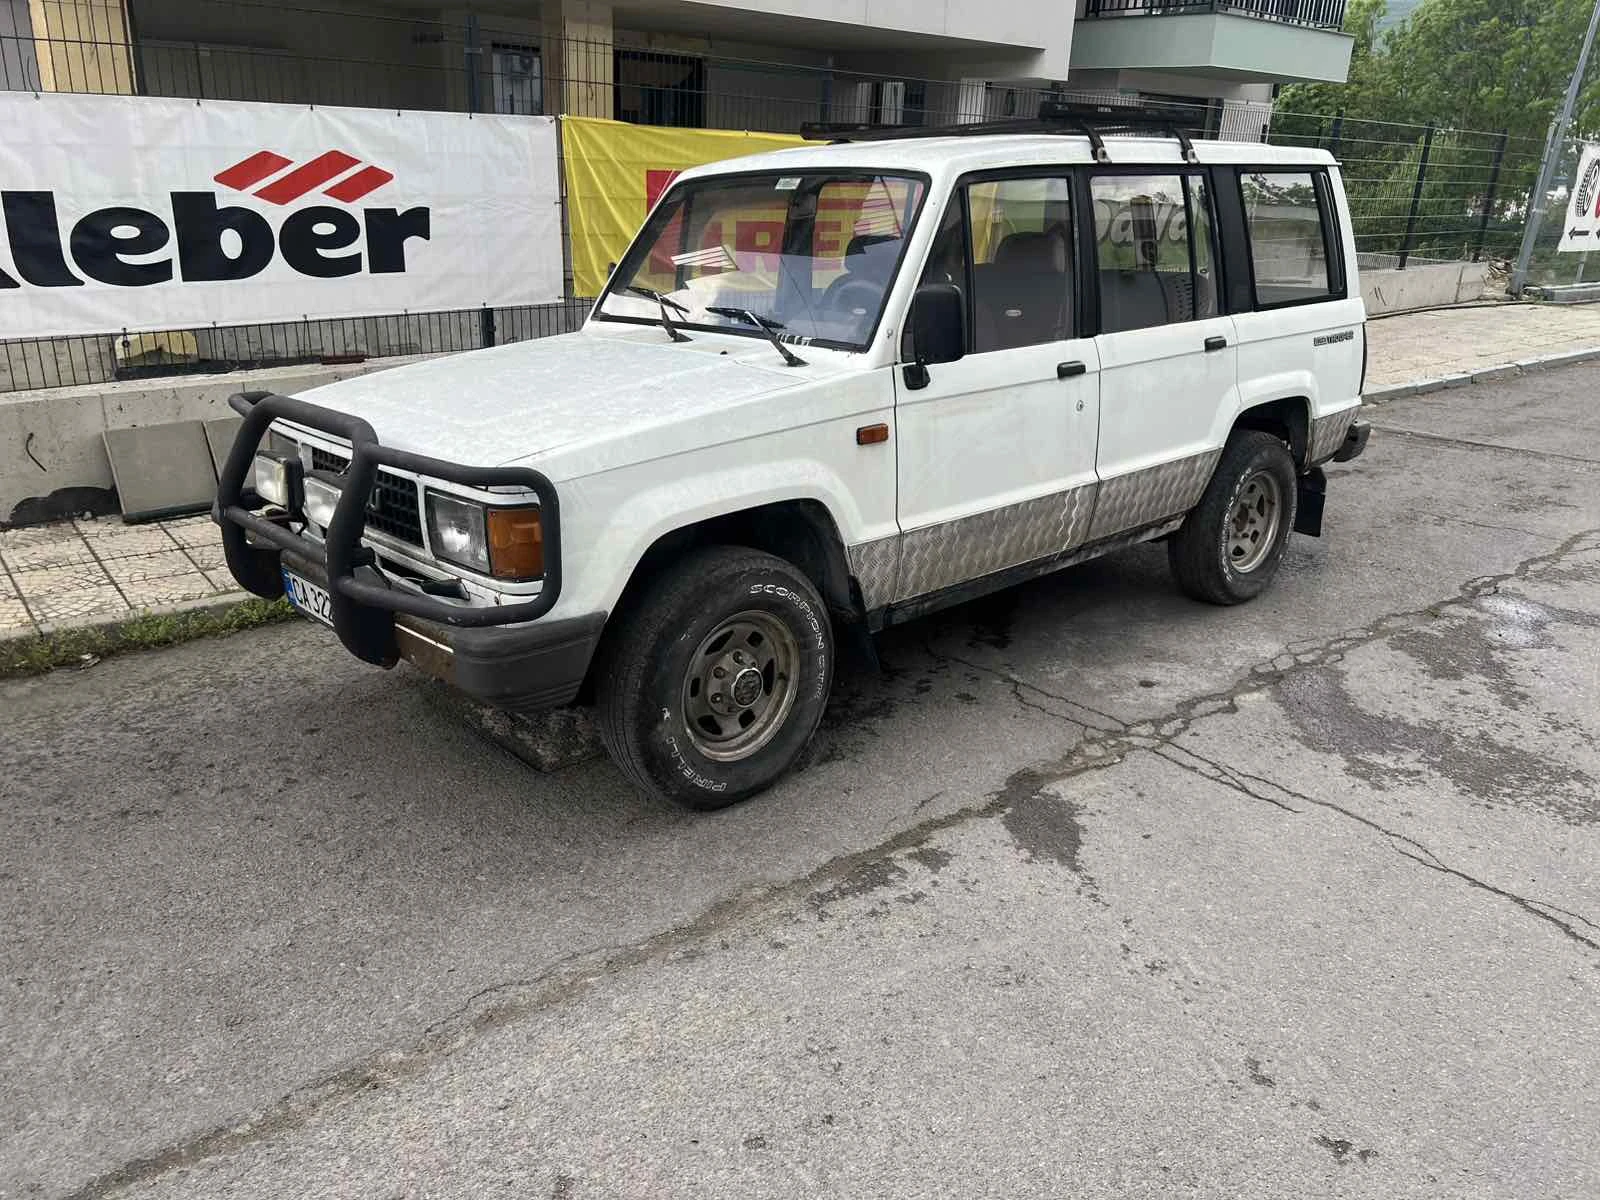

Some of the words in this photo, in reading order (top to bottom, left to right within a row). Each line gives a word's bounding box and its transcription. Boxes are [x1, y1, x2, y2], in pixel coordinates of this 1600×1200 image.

[0, 191, 430, 288] leber
[749, 584, 825, 650] SCORPION
[665, 736, 727, 792] PIRELLI
